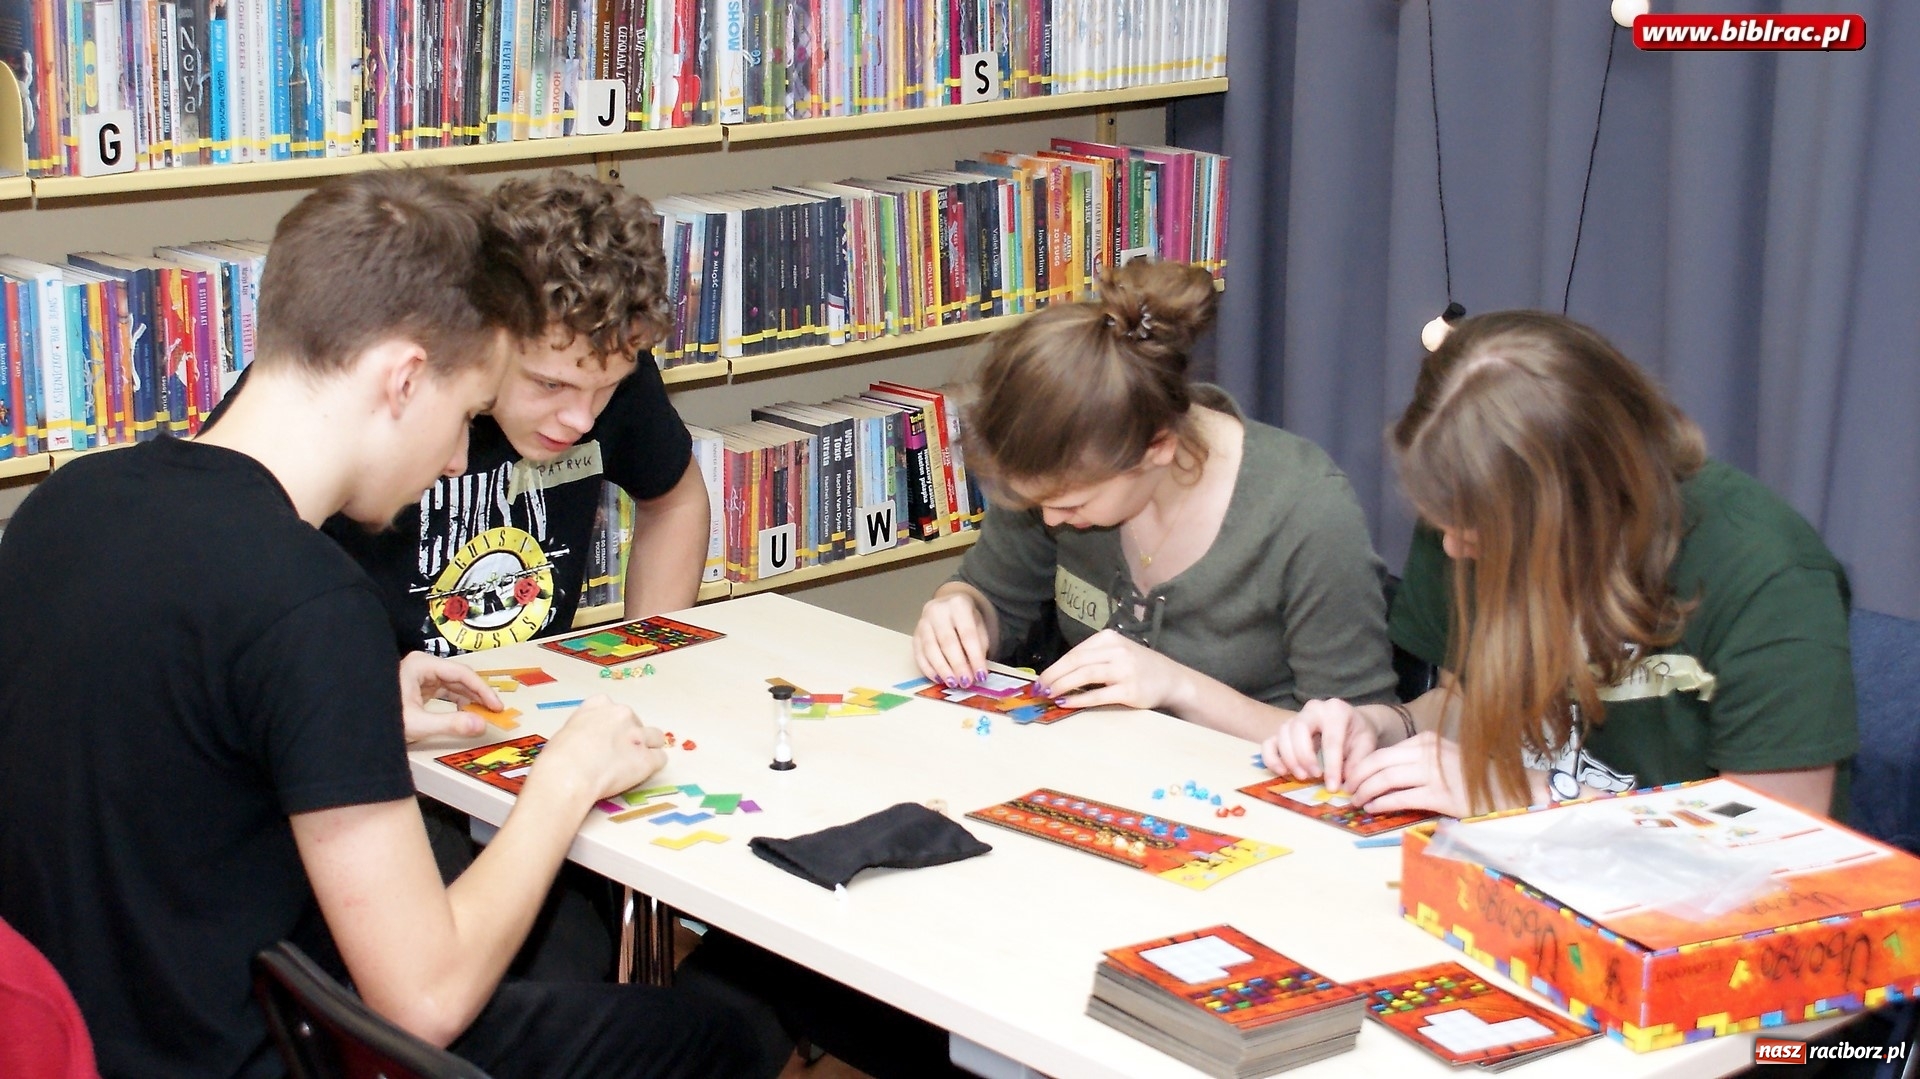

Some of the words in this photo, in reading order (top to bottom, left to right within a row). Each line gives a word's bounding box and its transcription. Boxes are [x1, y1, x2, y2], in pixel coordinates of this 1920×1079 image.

[538, 6, 548, 52] dziewczyna
[728, 1, 740, 51] SHOW
[502, 40, 511, 70] NEVER
[616, 26, 628, 69] CZEKOLADA
[501, 73, 510, 103] NEVER
[535, 73, 544, 115] HOOVER
[553, 71, 561, 113] HOOVER
[975, 60, 990, 95] S
[598, 89, 616, 127] J
[99, 123, 121, 166] G
[1053, 189, 1062, 220] Online
[1037, 245, 1045, 276] Stirling
[48, 298, 59, 320] JEANS
[243, 314, 252, 354] PENELOPA
[0, 343, 8, 385] Rekordowa
[822, 436, 831, 466] Utrata
[834, 437, 843, 461] Toxic
[844, 429, 853, 458] Wstyd
[536, 456, 592, 477] PATRYK
[917, 451, 925, 476] Telefon
[919, 477, 929, 504] pułapka
[867, 508, 891, 546] W
[454, 530, 506, 570] GUNS
[771, 532, 787, 568] U
[1060, 579, 1097, 621] Alicja
[456, 615, 537, 649] ROSES
